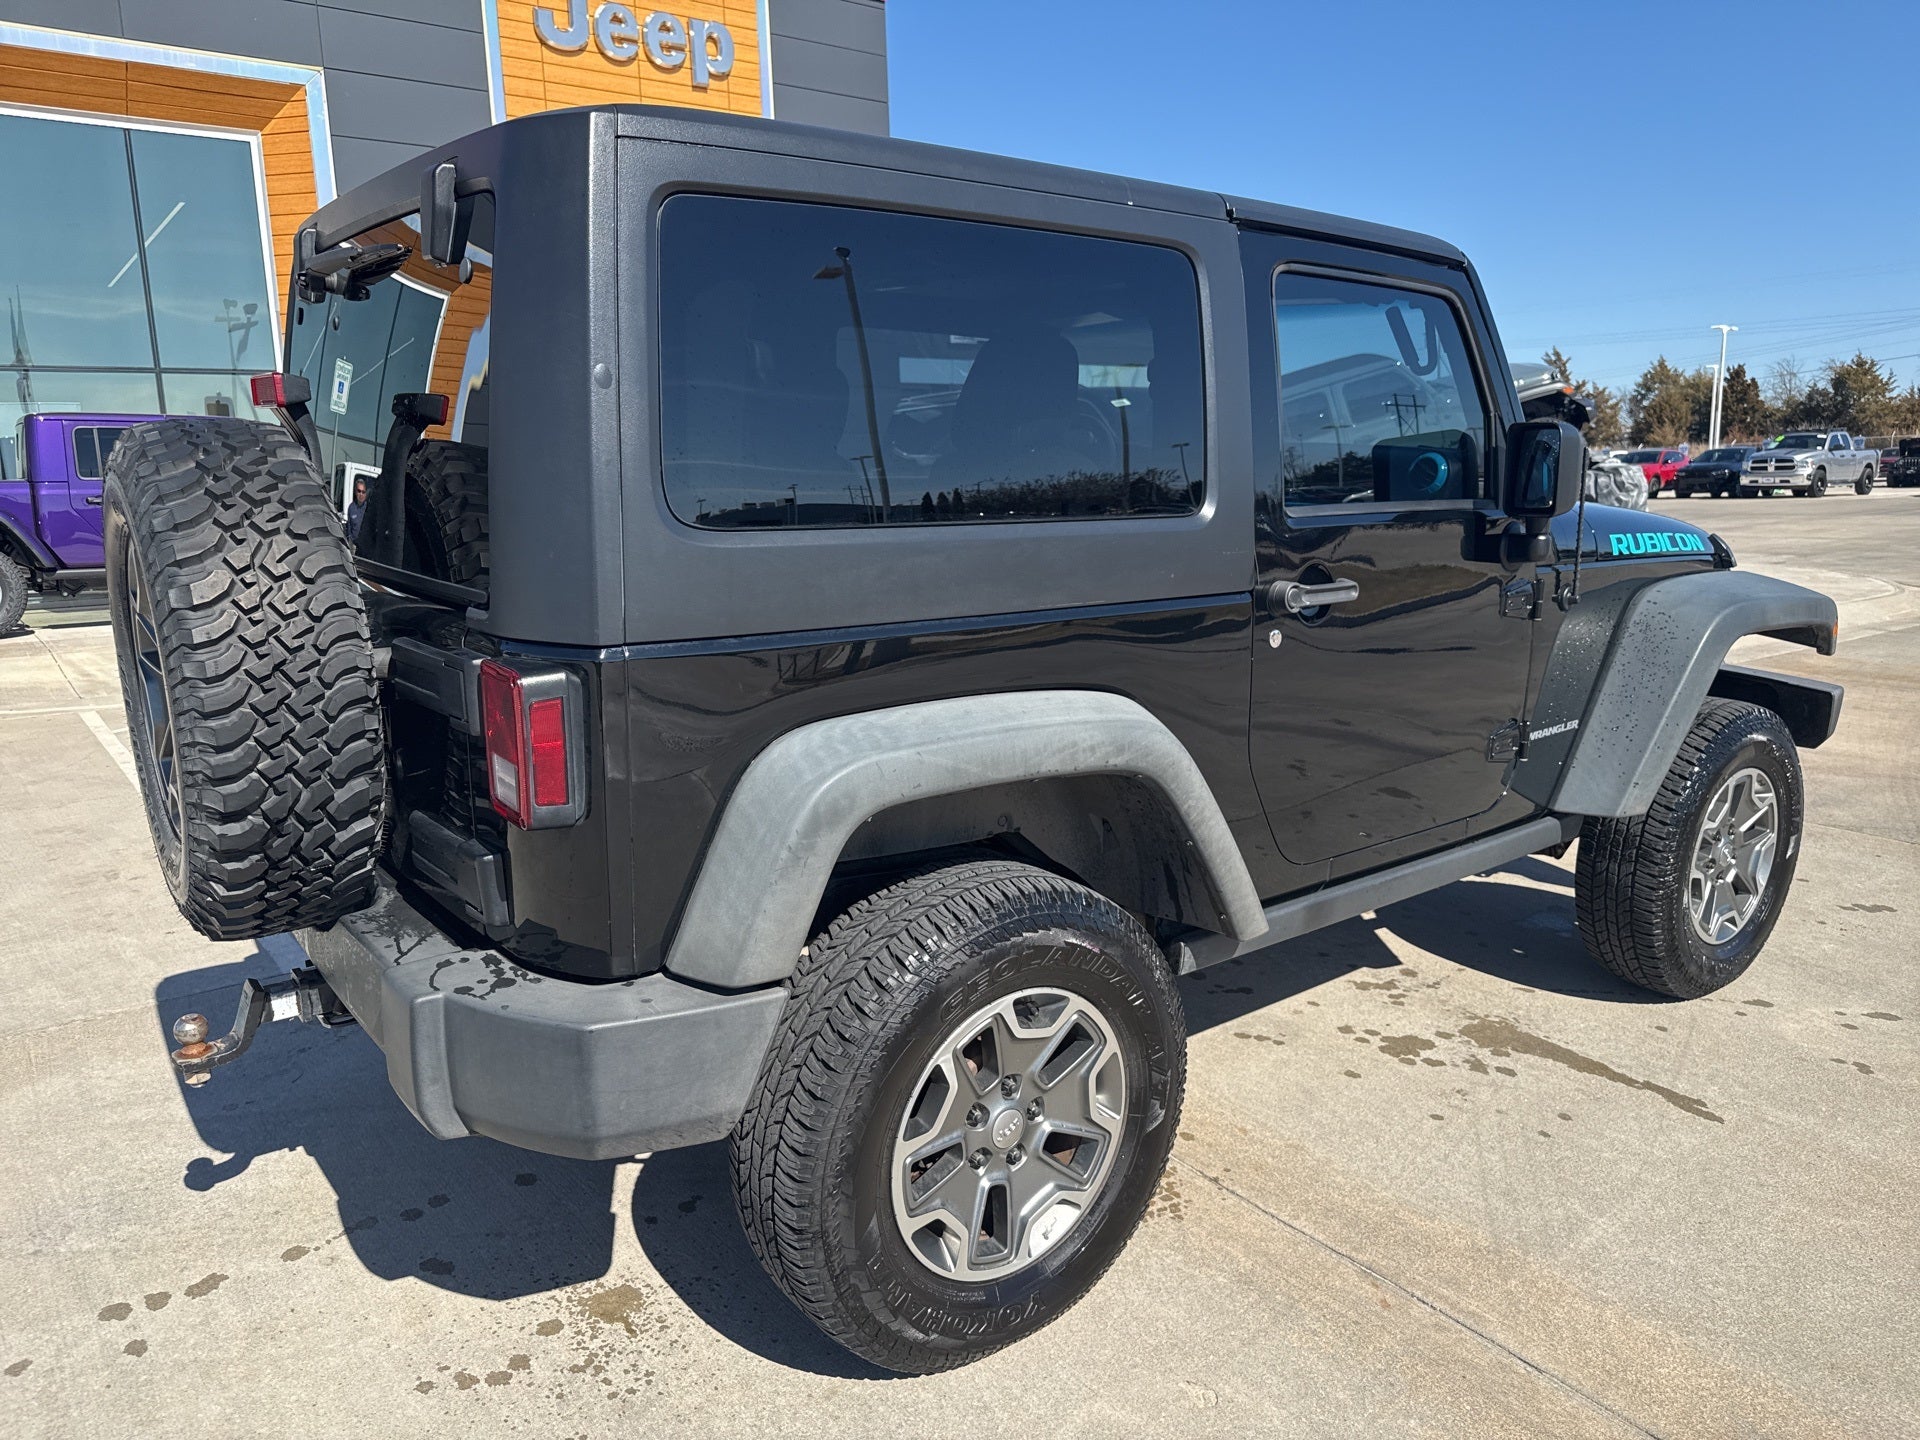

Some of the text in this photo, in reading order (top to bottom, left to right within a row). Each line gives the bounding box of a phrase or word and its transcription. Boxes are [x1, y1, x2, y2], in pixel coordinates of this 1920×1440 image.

[533, 0, 735, 88] Jeep
[1609, 532, 1705, 556] RUBICON
[1529, 719, 1579, 741] WRANGLER
